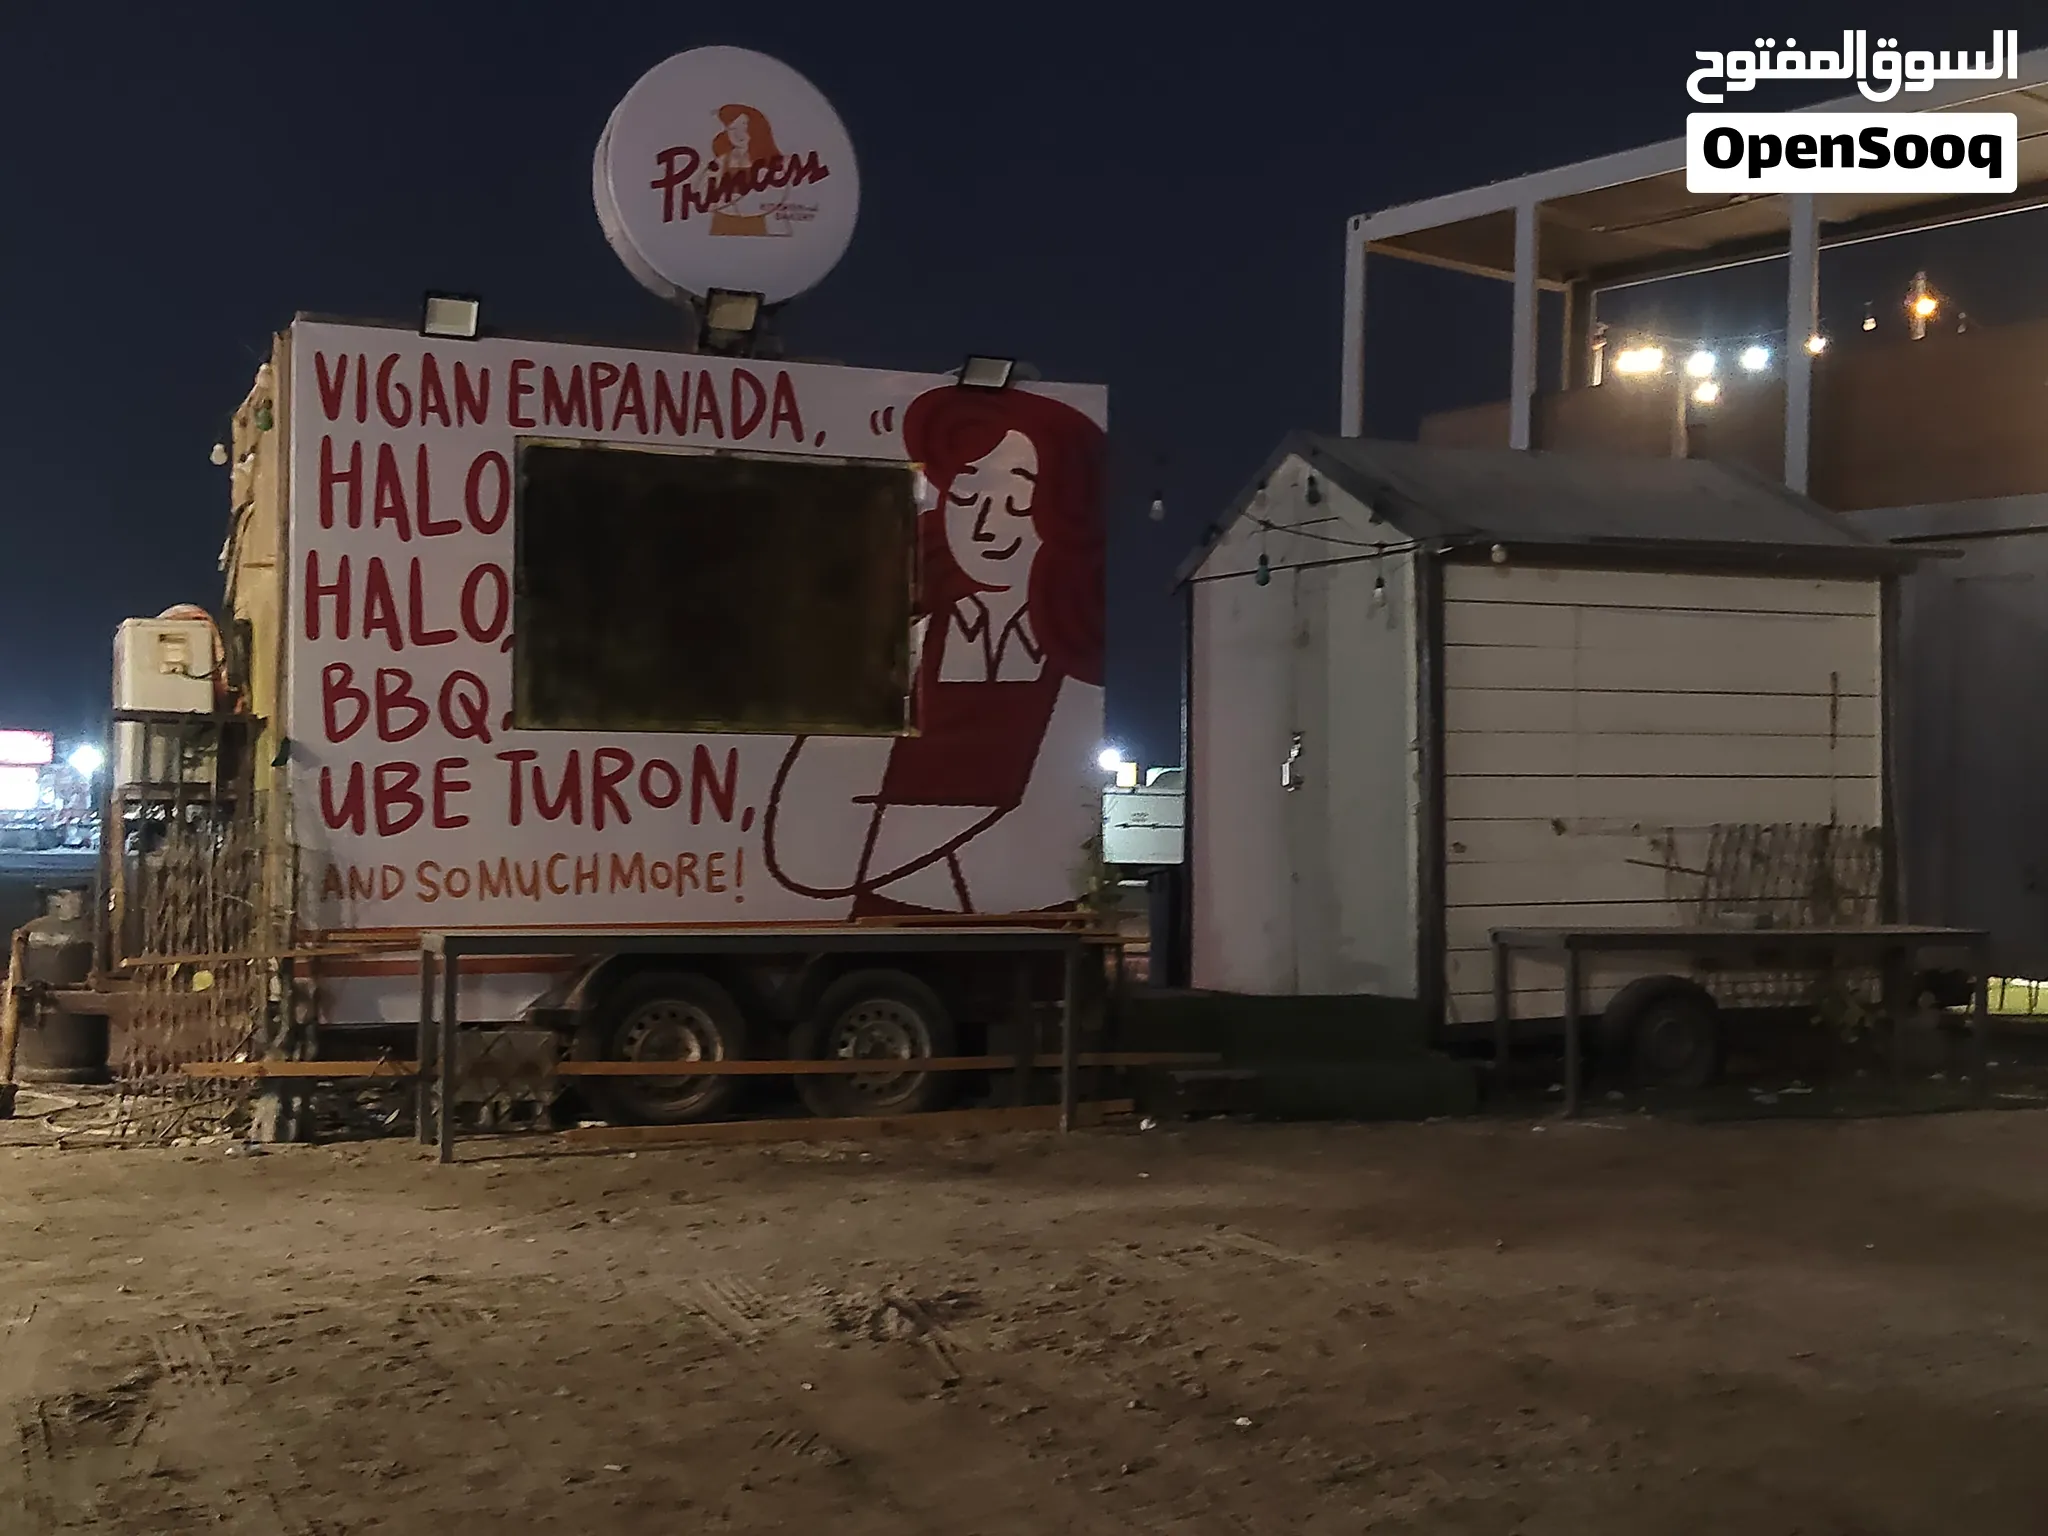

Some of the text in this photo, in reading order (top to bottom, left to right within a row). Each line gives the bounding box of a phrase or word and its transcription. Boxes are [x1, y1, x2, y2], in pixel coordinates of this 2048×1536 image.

[651, 146, 830, 224] Princess
[314, 350, 827, 448] VIGAN EMPANADA,
[318, 434, 511, 543] HALO
[318, 744, 756, 837] UBE TURON,
[321, 846, 747, 904] AND SO MUCH MORE!
